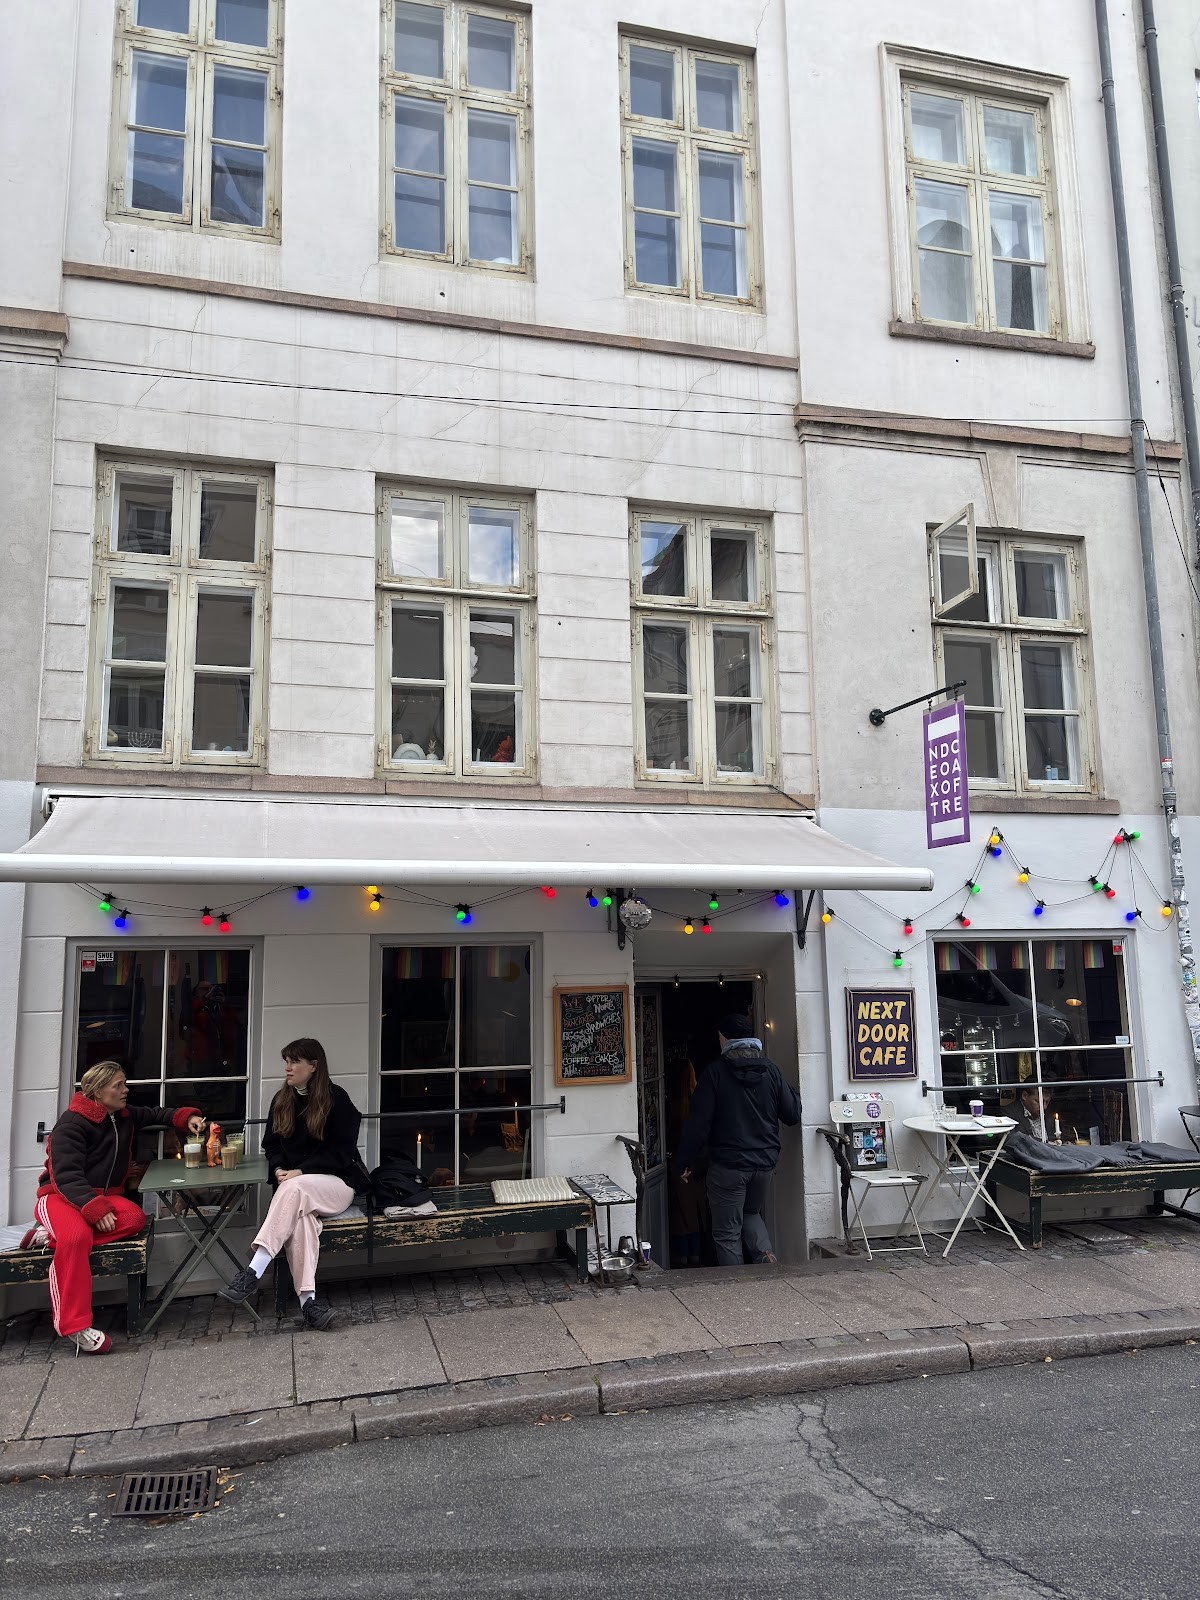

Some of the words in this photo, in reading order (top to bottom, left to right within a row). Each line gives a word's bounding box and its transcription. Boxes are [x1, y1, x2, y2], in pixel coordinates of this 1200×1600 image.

[857, 1001, 907, 1020] NEXT
[562, 1030, 586, 1040] EGGS
[857, 1023, 910, 1043] DOOR
[562, 1057, 590, 1065] COFFEE
[594, 1052, 620, 1066] CAKES
[859, 1046, 907, 1066] CAFE
